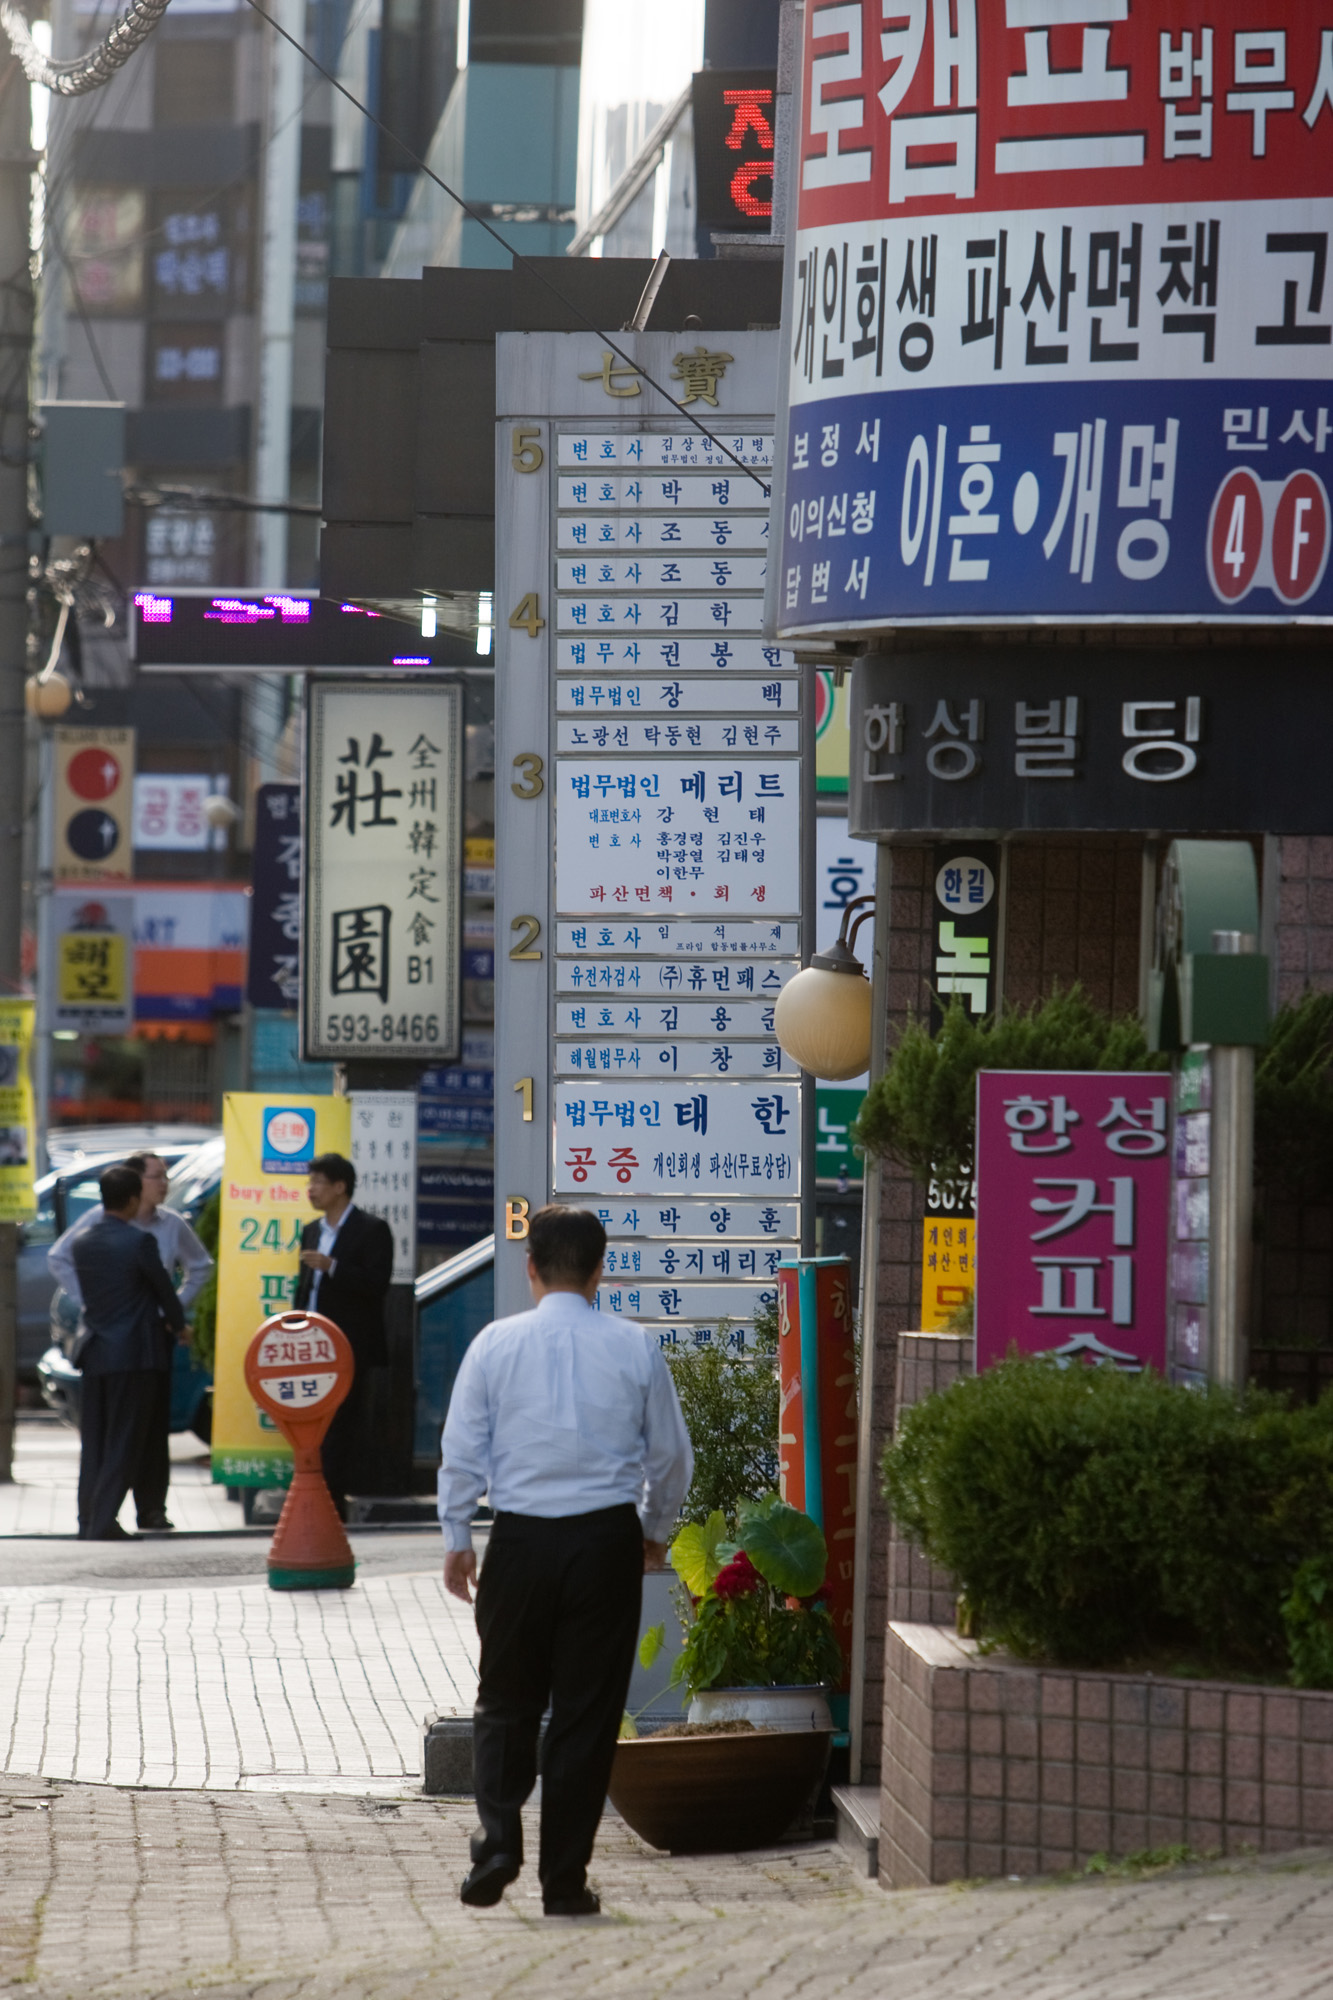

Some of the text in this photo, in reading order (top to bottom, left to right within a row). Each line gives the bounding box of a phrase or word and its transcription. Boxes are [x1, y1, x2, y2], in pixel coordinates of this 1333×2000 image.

[802, 0, 1145, 203] 로캠프
[795, 233, 938, 384] 개인회생
[961, 219, 1221, 371] 파산면책
[577, 346, 735, 407] 七寶
[512, 427, 544, 475] 5
[661, 454, 698, 465] 법무법인
[732, 436, 775, 453] 김병
[789, 490, 877, 542] 이의신청
[508, 592, 546, 638] 4
[570, 686, 641, 707] 법무법인
[570, 725, 783, 747] 노광선 탁동현 김현주
[862, 696, 1201, 784] 한성빌딩
[510, 752, 545, 800] 3
[570, 770, 786, 804] 법무법인 메리트
[588, 808, 642, 824] 대표변호사
[716, 831, 767, 847] 김진우
[656, 848, 766, 864] 박광열 김태영
[944, 867, 985, 904] 한길
[508, 914, 543, 961] 2
[407, 955, 434, 985] B1
[570, 965, 641, 989] 유전자검사
[326, 1012, 440, 1044] 593-8466
[513, 1077, 534, 1122] 1
[565, 1099, 661, 1128] 법무법인
[1002, 1095, 1168, 1155] 한성
[564, 1146, 640, 1184] 공증
[653, 1151, 701, 1180] 개인회생
[230, 1183, 300, 1204] buy the
[928, 1226, 977, 1248] 개인회
[603, 1250, 641, 1273] 증보험
[263, 1339, 332, 1363] 주차금지
[278, 1379, 318, 1400] 칠보
